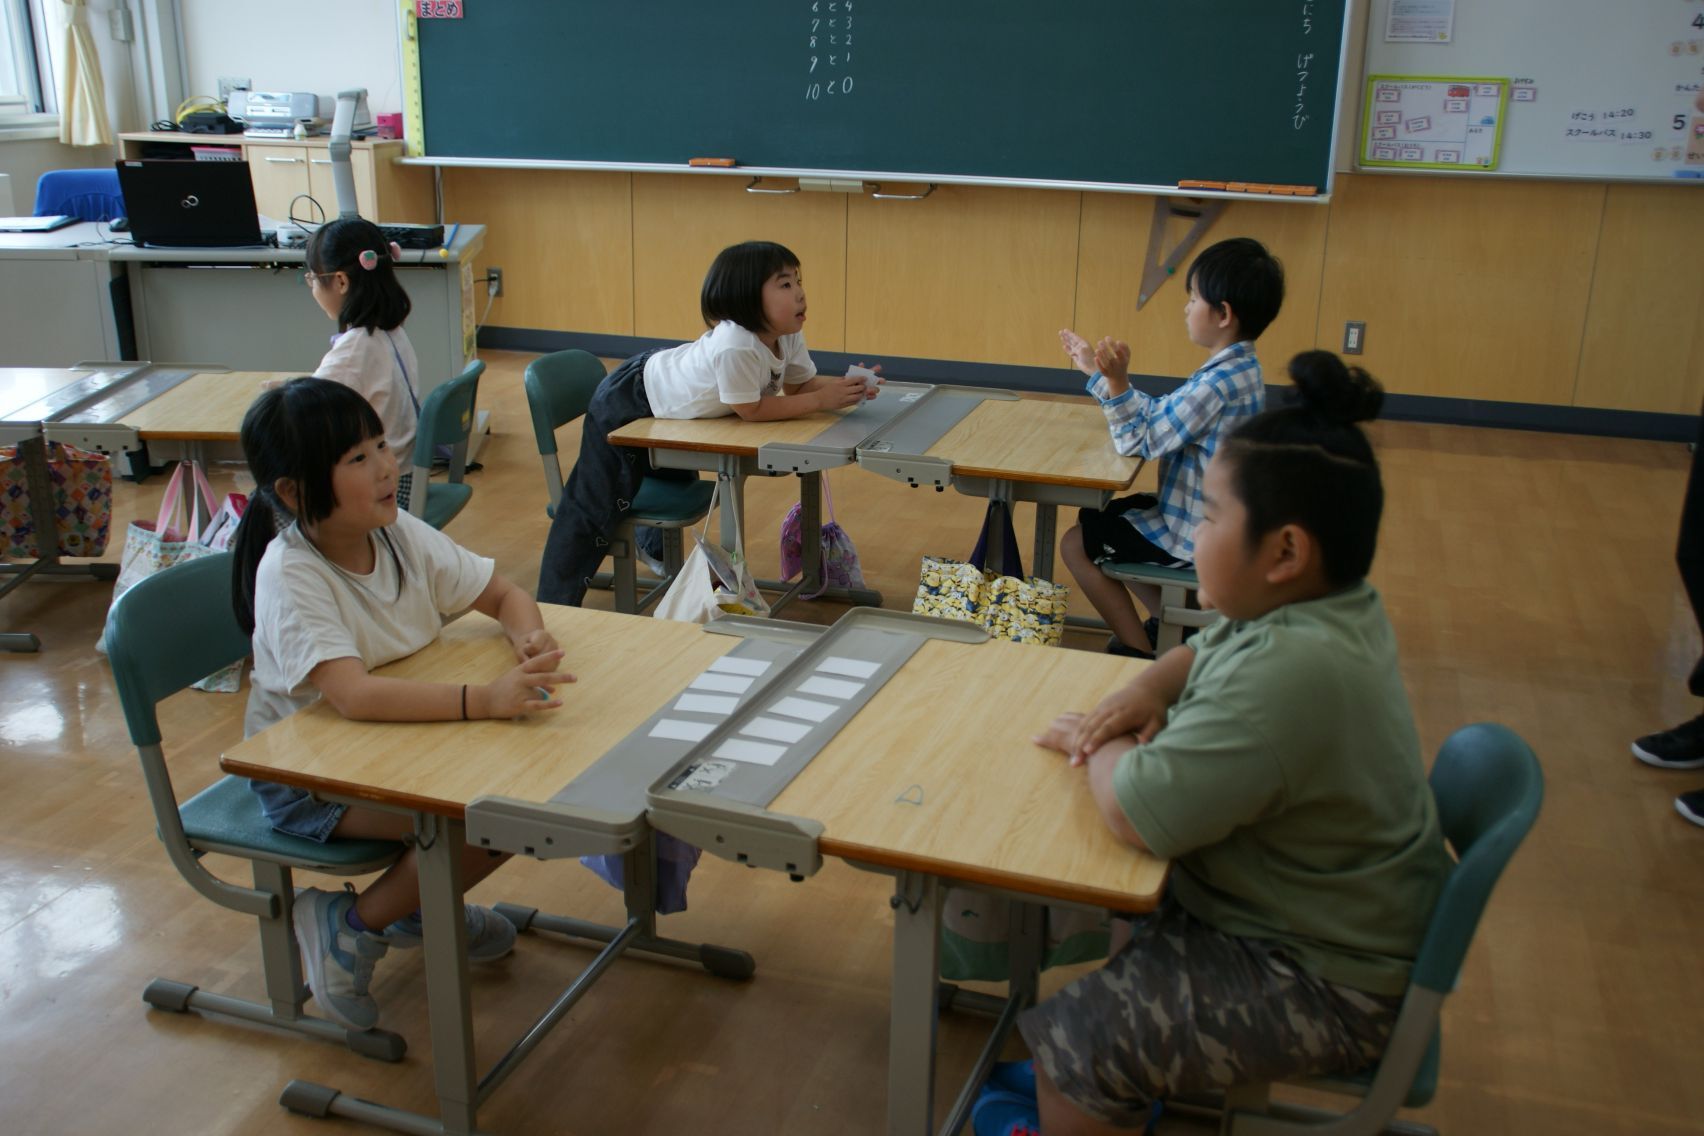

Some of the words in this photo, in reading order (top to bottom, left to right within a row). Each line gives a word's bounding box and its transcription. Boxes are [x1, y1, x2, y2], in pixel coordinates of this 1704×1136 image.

[420, 0, 458, 17] まとめ
[1303, 0, 1314, 34] にち
[1691, 13, 1704, 30] 4
[1292, 53, 1315, 130] げつようび
[1571, 111, 1595, 121] げこう
[1672, 114, 1687, 130] 5
[1565, 128, 1617, 137] スクールバス
